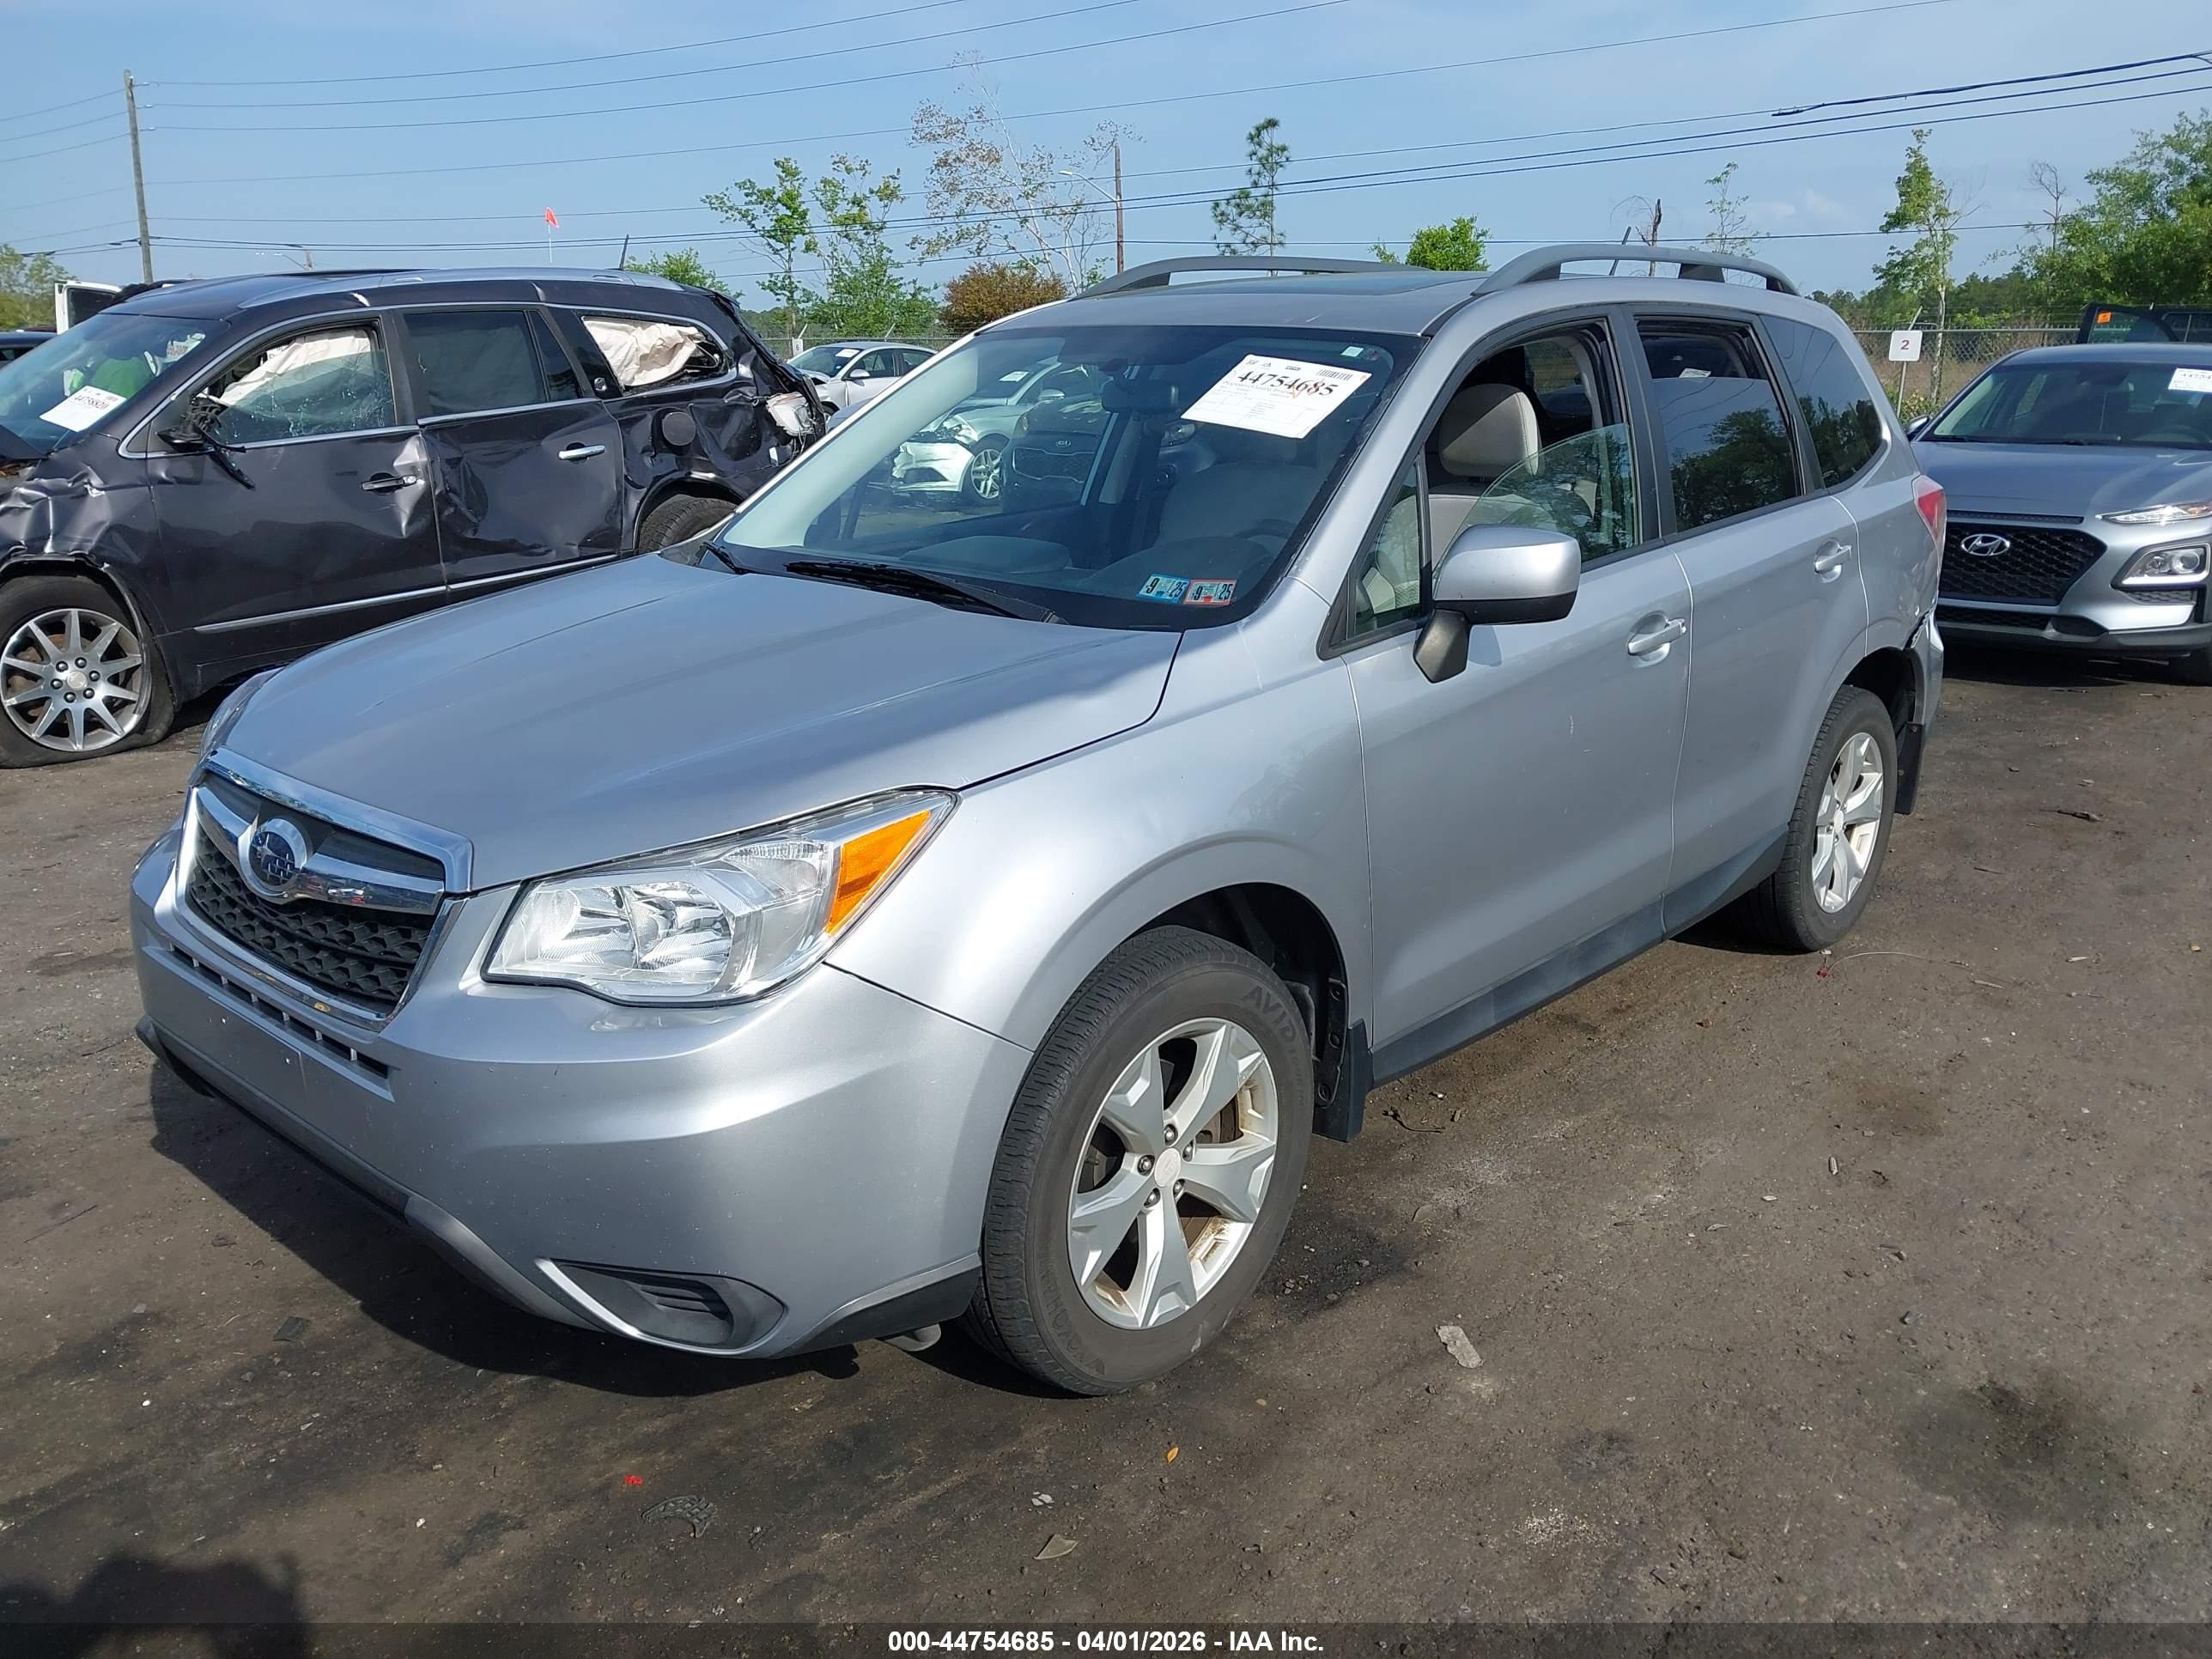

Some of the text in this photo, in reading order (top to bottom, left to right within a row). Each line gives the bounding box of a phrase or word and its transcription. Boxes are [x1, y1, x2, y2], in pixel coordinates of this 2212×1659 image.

[1900, 339, 1911, 350] 2
[1237, 371, 1340, 396] 44754685
[1145, 577, 1160, 594] 9
[1242, 984, 1297, 1045] AVID
